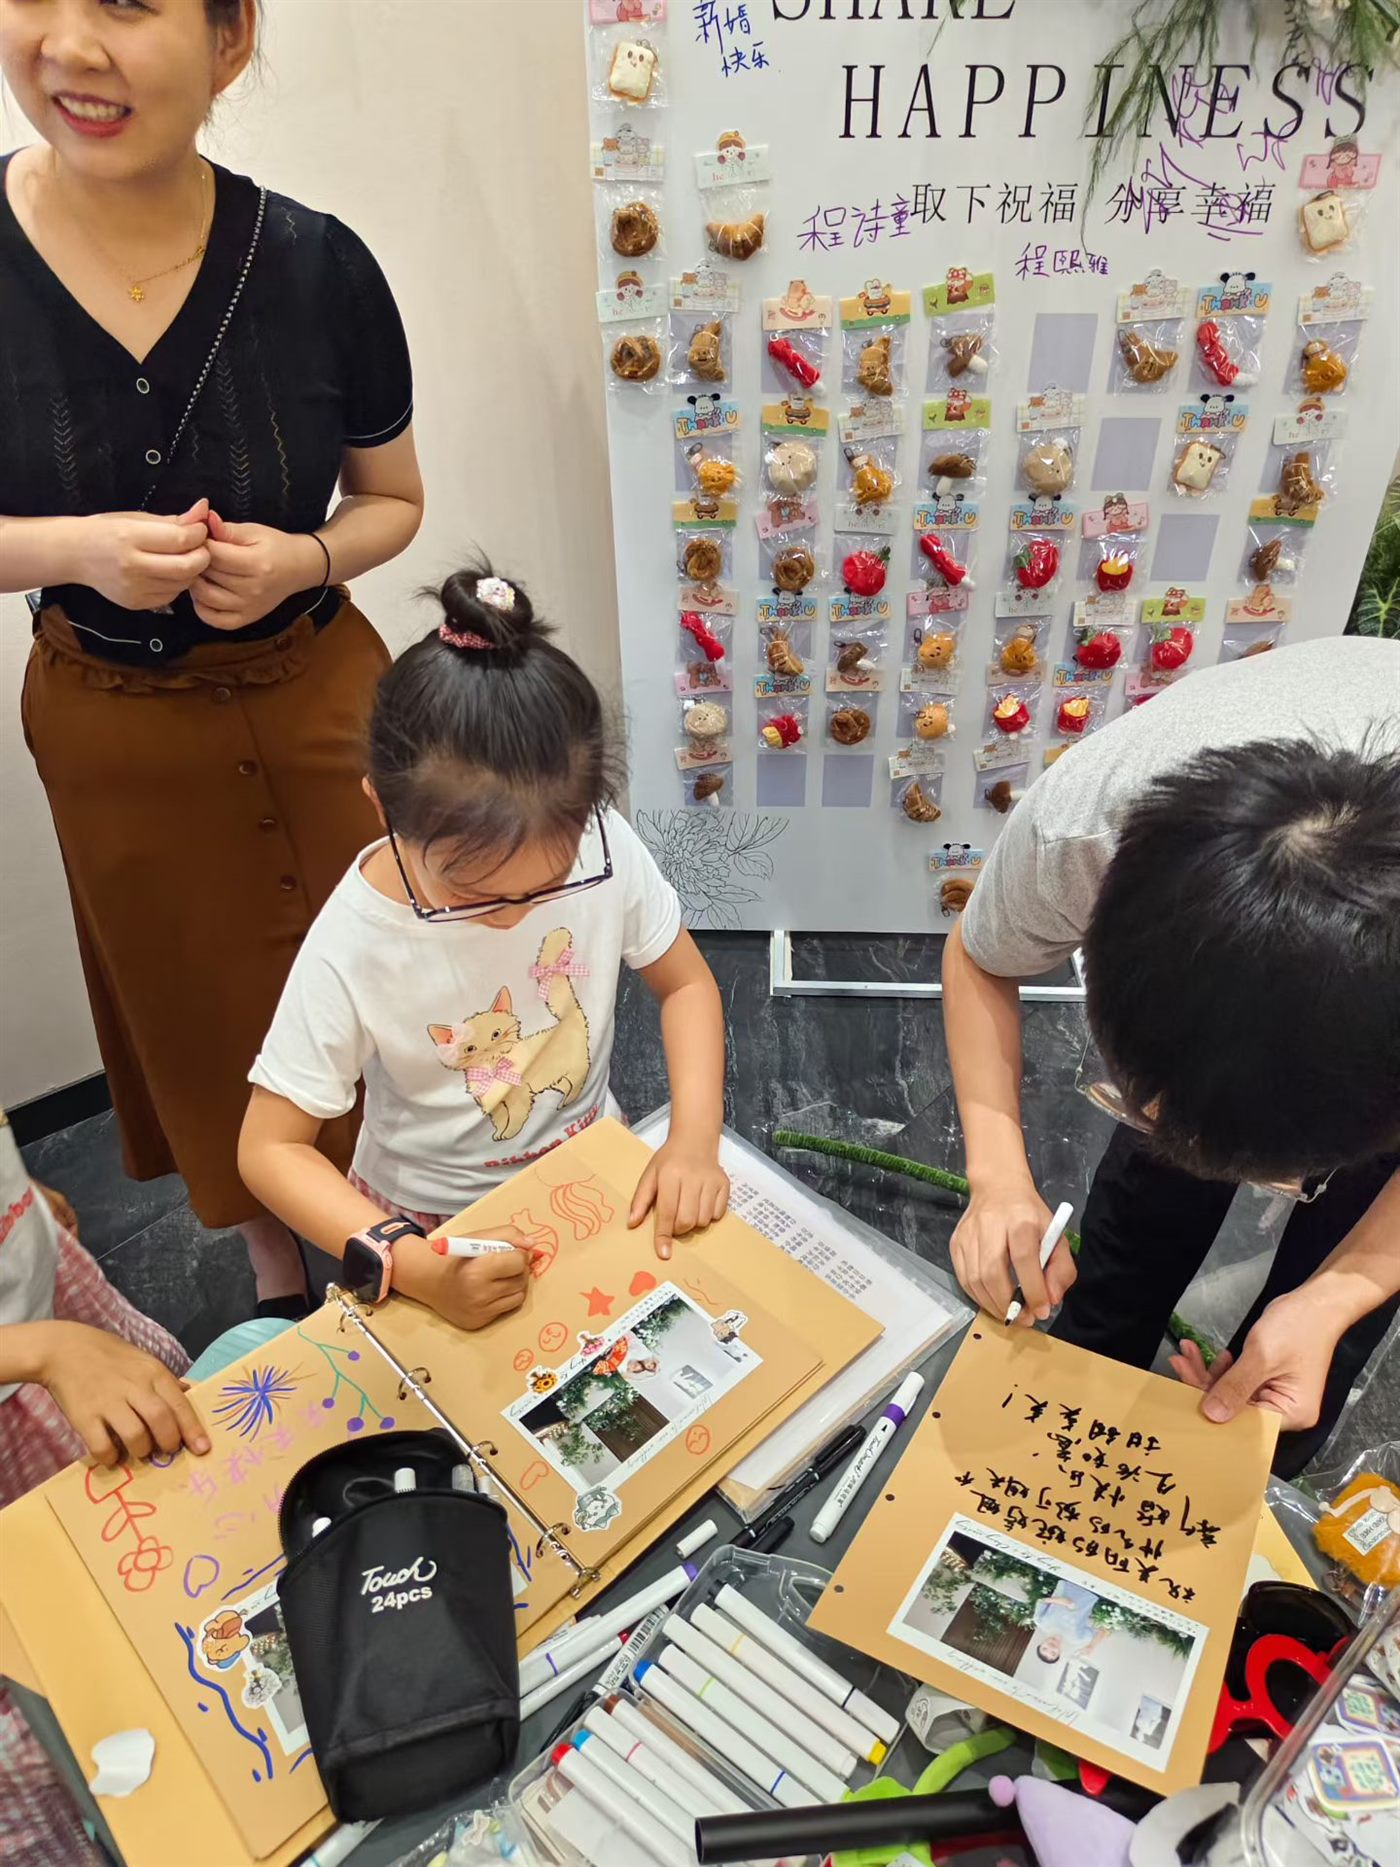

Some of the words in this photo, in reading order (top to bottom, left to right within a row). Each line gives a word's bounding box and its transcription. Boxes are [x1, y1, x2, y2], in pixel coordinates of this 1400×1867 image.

[721, 41, 770, 78] 快乐
[838, 63, 1374, 139] HAPPINESS
[797, 193, 913, 252] 程诗童
[911, 182, 1079, 225] 取下祝福
[1105, 182, 1276, 225] 分享幸福
[361, 1556, 437, 1595] Touch
[371, 1586, 433, 1613] 24pcs
